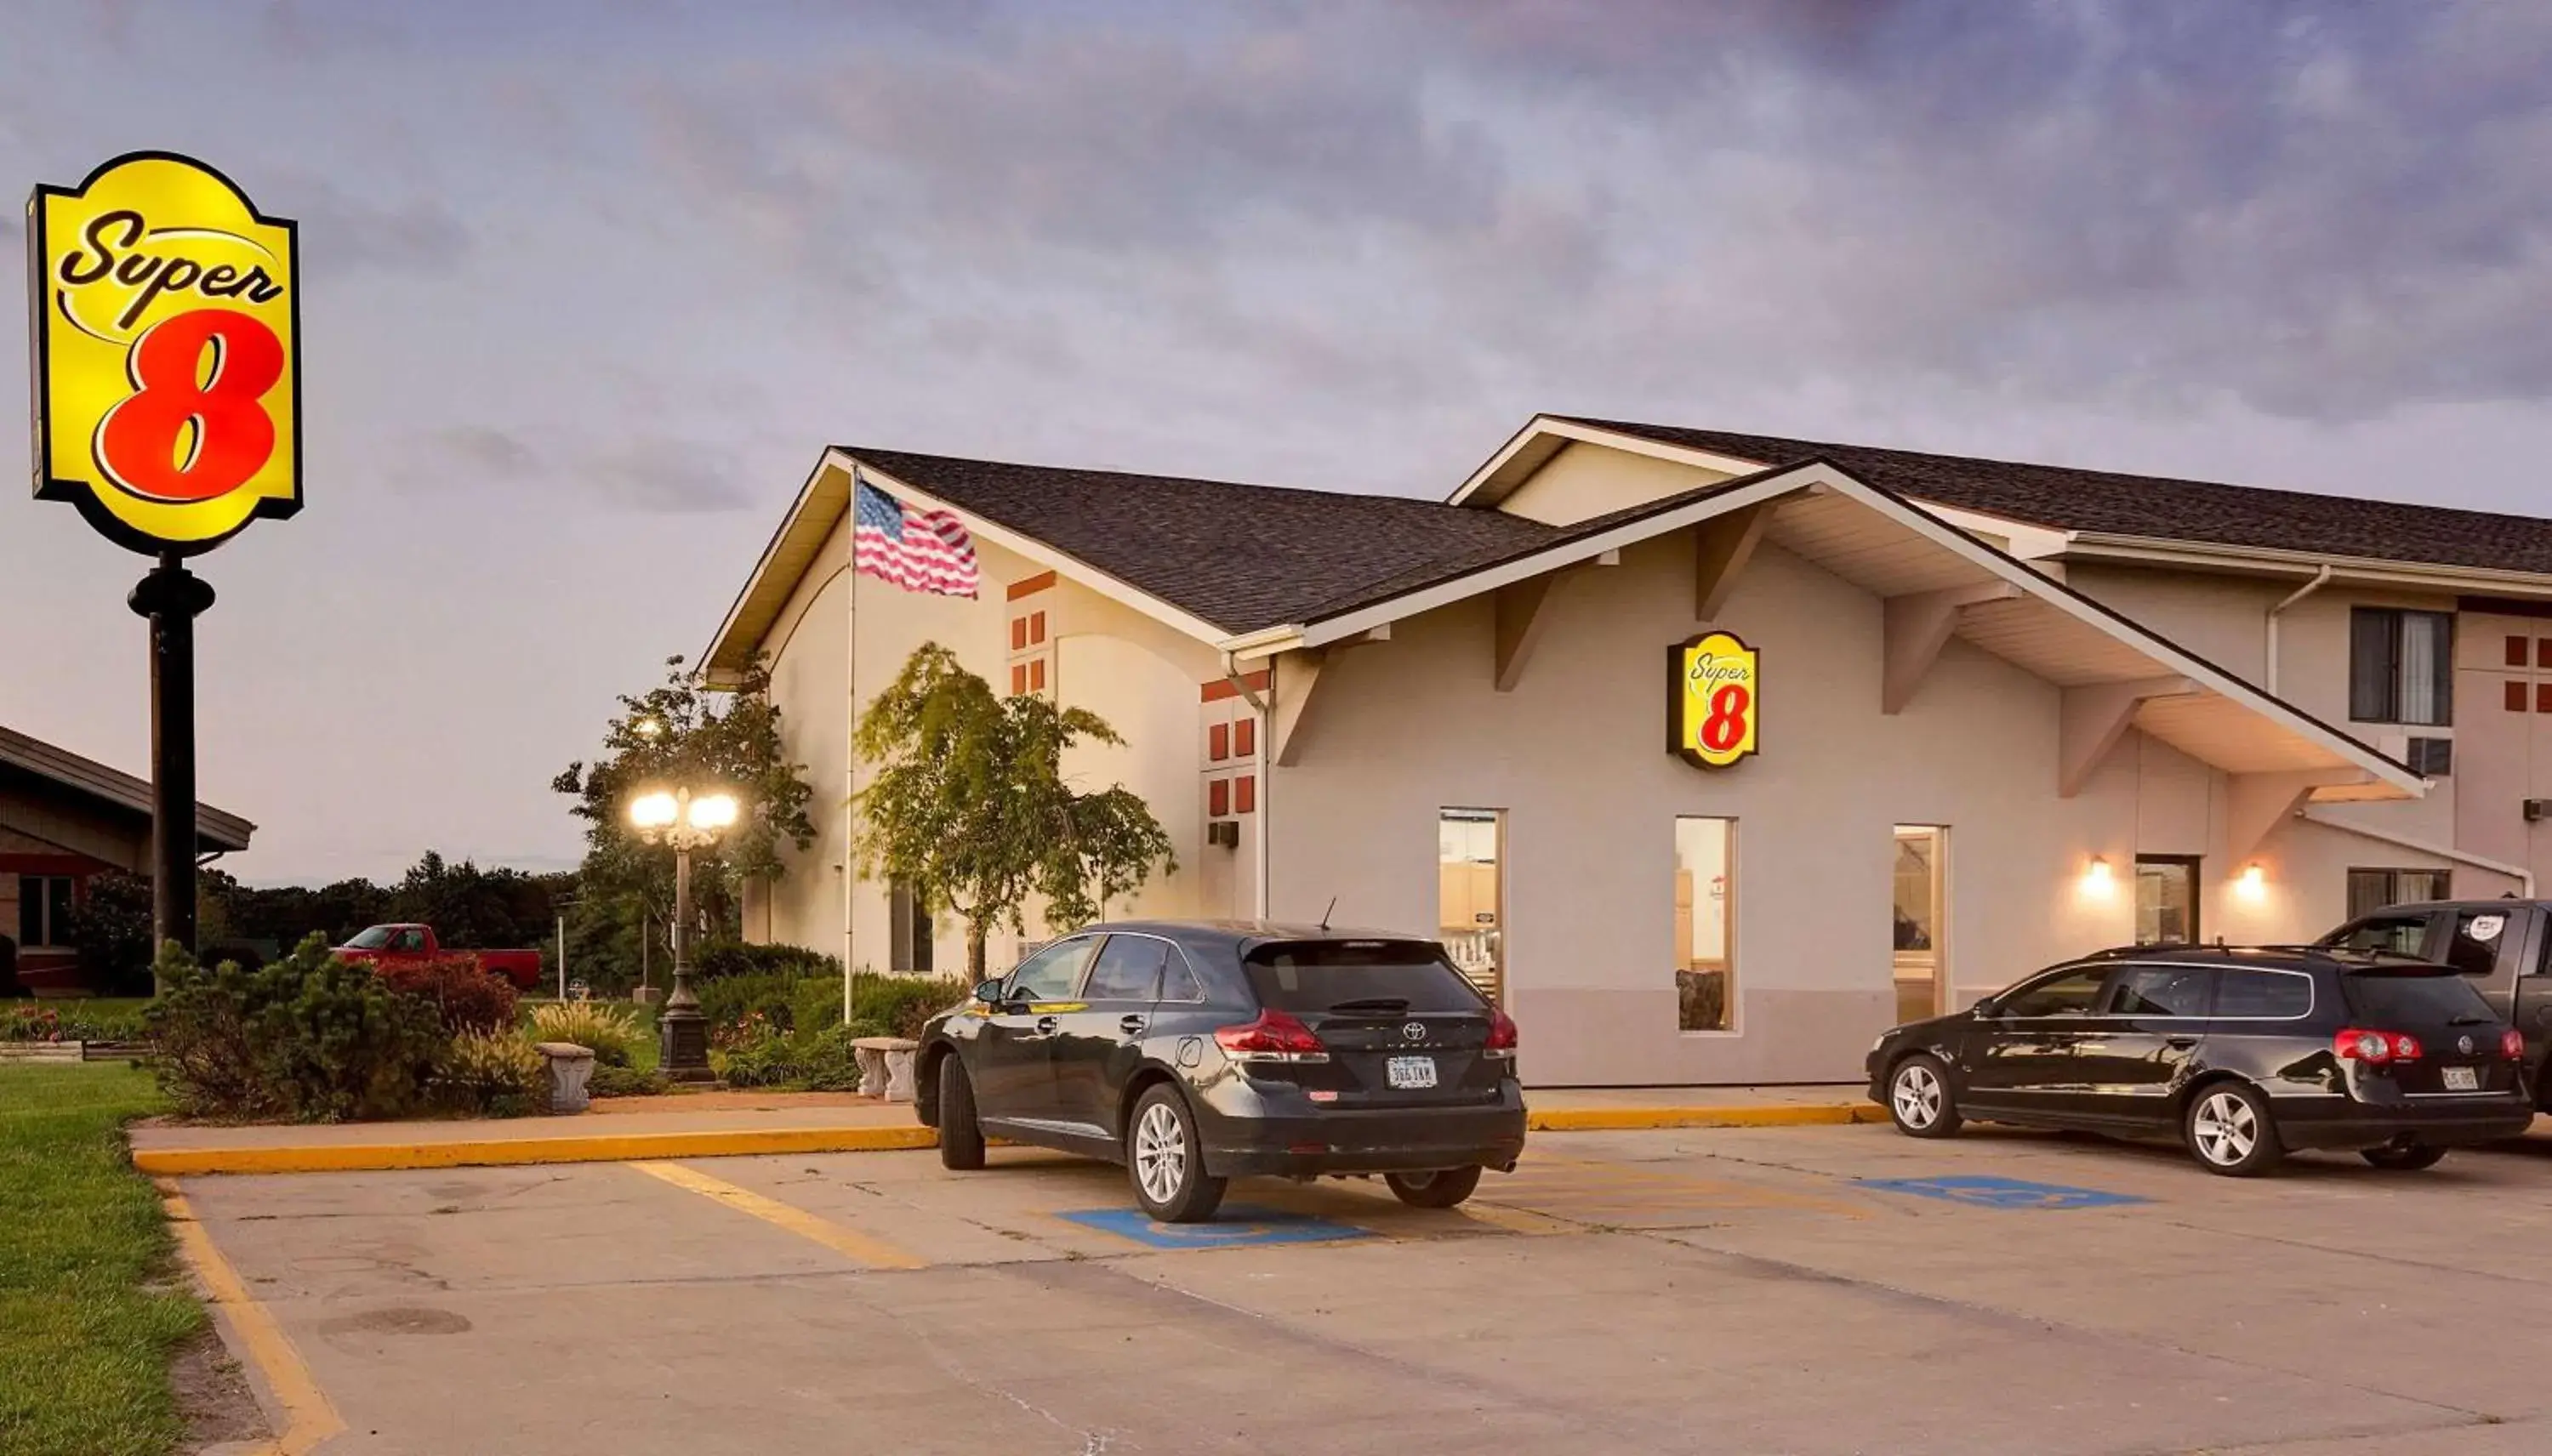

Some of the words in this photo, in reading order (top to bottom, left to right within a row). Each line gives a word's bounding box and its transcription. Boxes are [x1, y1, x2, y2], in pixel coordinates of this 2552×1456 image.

[60, 210, 283, 331] Super
[93, 309, 284, 503] 8
[1690, 652, 1750, 693] Super
[1699, 684, 1750, 752] 8
